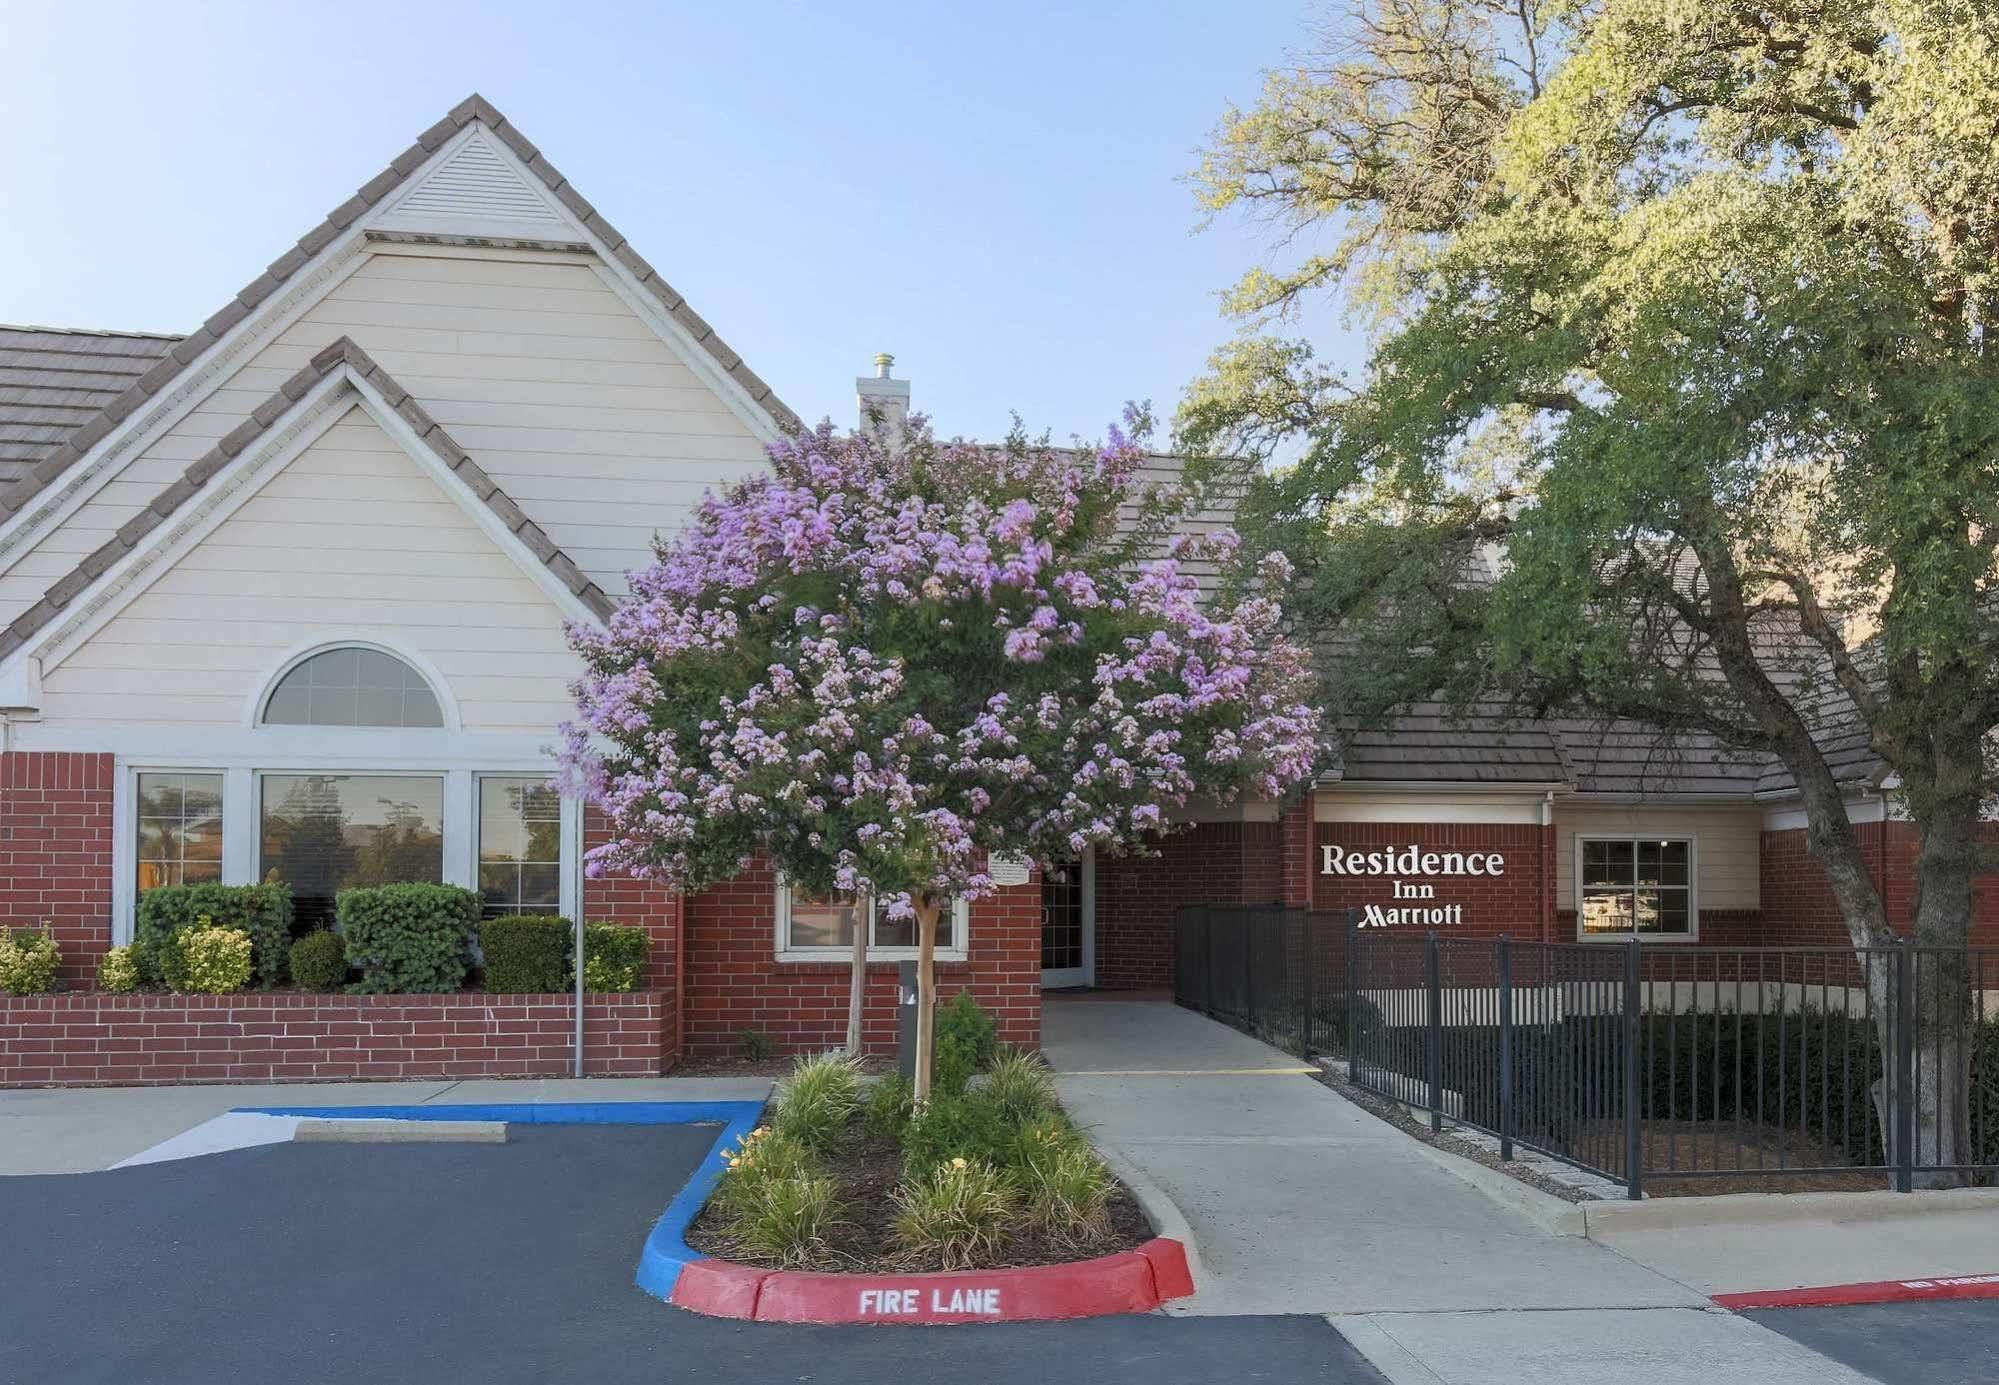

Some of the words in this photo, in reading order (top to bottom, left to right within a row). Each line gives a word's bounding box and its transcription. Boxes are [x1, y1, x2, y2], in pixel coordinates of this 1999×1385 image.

[1320, 845, 1504, 876] Residence
[1392, 880, 1435, 899] Inn
[1357, 904, 1462, 928] Marriott
[859, 1289, 920, 1314] FIRE
[932, 1289, 1001, 1314] LANE
